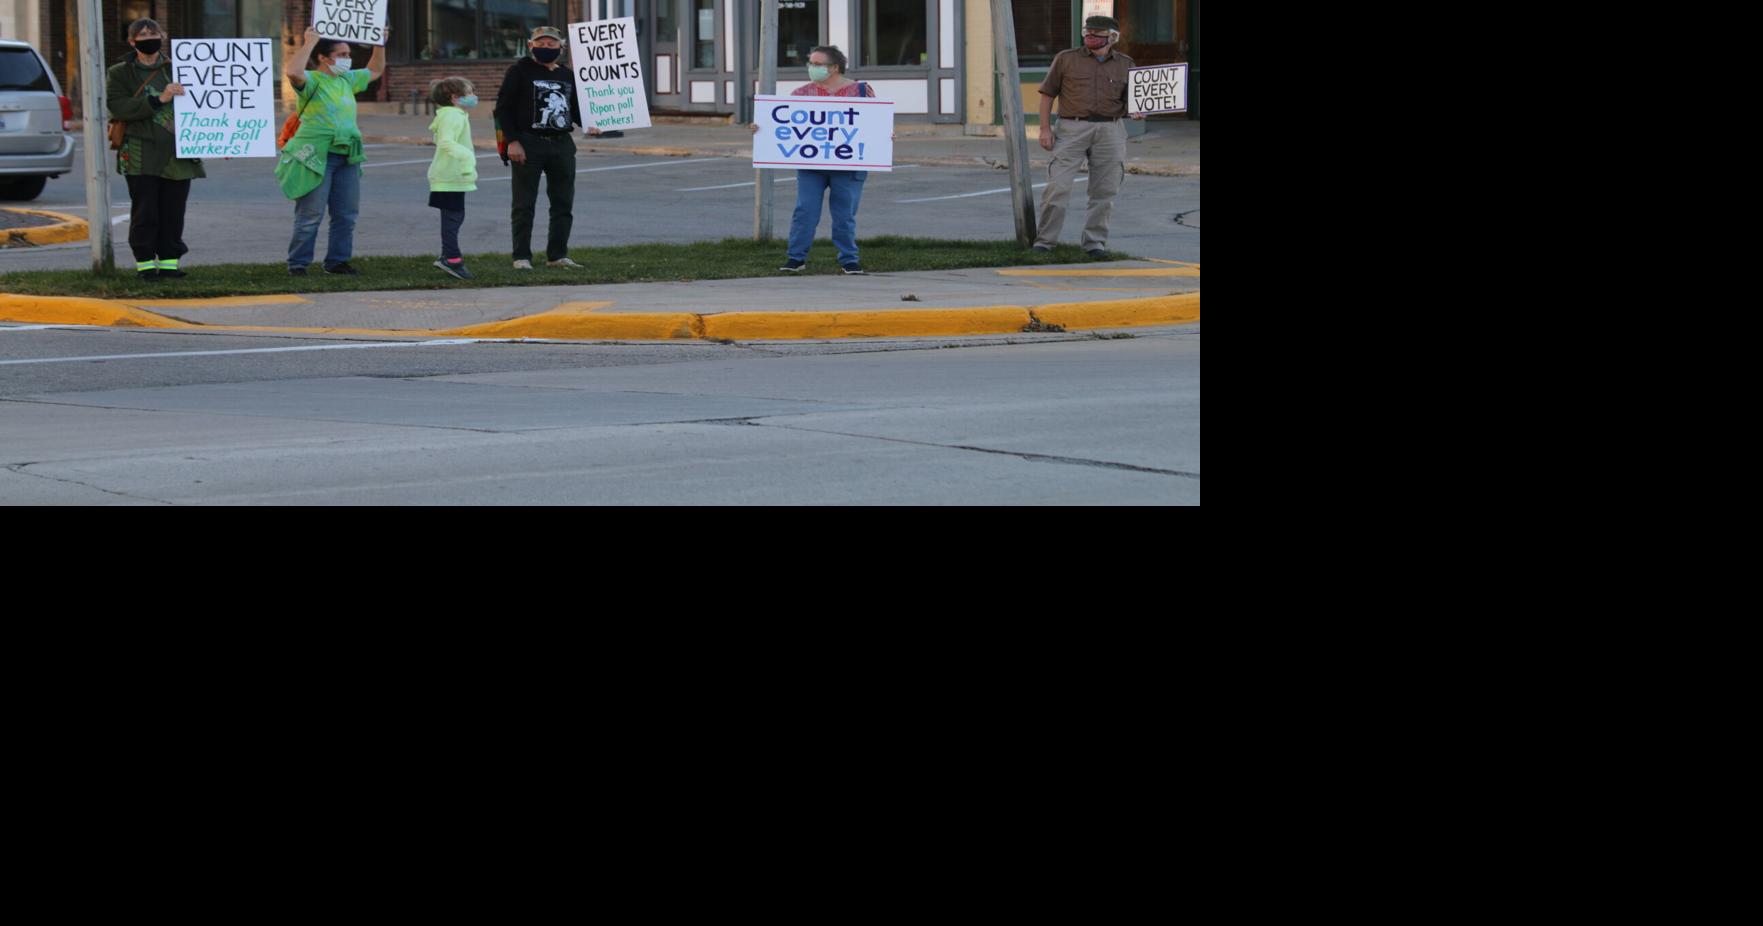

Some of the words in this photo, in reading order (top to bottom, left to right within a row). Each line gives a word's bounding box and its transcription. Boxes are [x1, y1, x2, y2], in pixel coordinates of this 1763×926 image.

[325, 7, 374, 26] VOTE
[315, 20, 381, 41] COUNTS
[578, 23, 626, 44] EVERY
[586, 41, 626, 61] VOTE
[176, 64, 269, 87] EVERY
[579, 61, 640, 82] COUNTS
[1134, 68, 1178, 84] COUNT
[584, 84, 614, 98] Thank
[617, 86, 635, 98] you
[1134, 81, 1178, 97] EVERY
[189, 89, 256, 109] VOTE
[589, 101, 615, 115] Ripon
[617, 97, 634, 114] poll
[1135, 95, 1176, 111] VOTE!
[179, 112, 229, 128] Thank
[236, 119, 268, 132] you
[595, 113, 634, 127] workers!
[771, 105, 860, 125] Count
[179, 128, 224, 144] Ripon
[230, 128, 261, 144] poll
[775, 126, 859, 144] every
[180, 142, 250, 155] workers!
[776, 142, 865, 160] vote!
